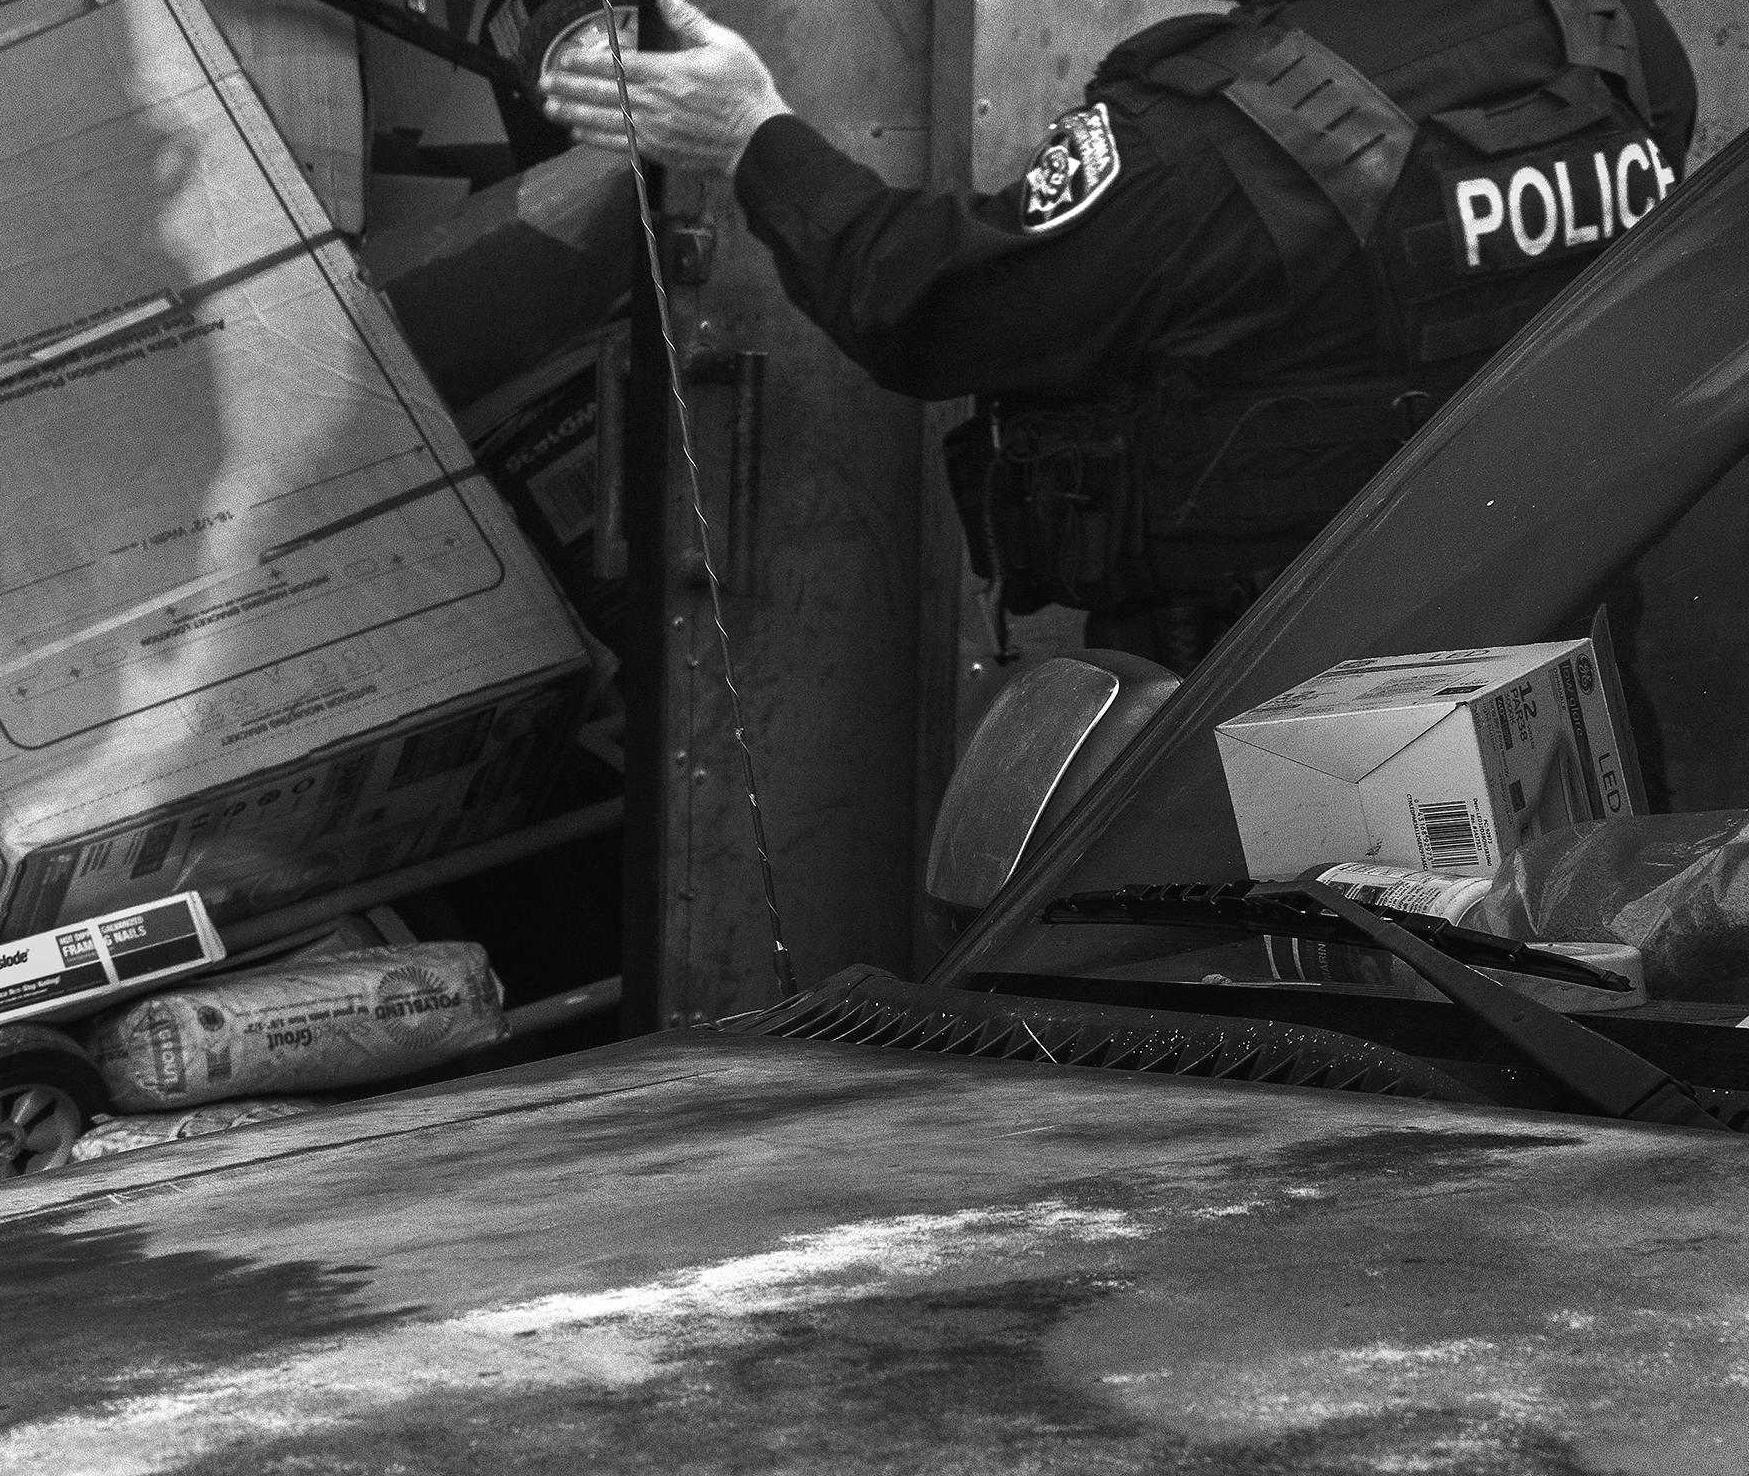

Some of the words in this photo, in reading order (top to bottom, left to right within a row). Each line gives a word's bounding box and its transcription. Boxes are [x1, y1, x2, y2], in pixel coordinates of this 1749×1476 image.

[1510, 687, 1528, 743] PAR38
[1518, 681, 1537, 721] 12
[1599, 752, 1621, 813] LED
[113, 925, 148, 943] NAILS
[266, 1027, 312, 1051] Grout
